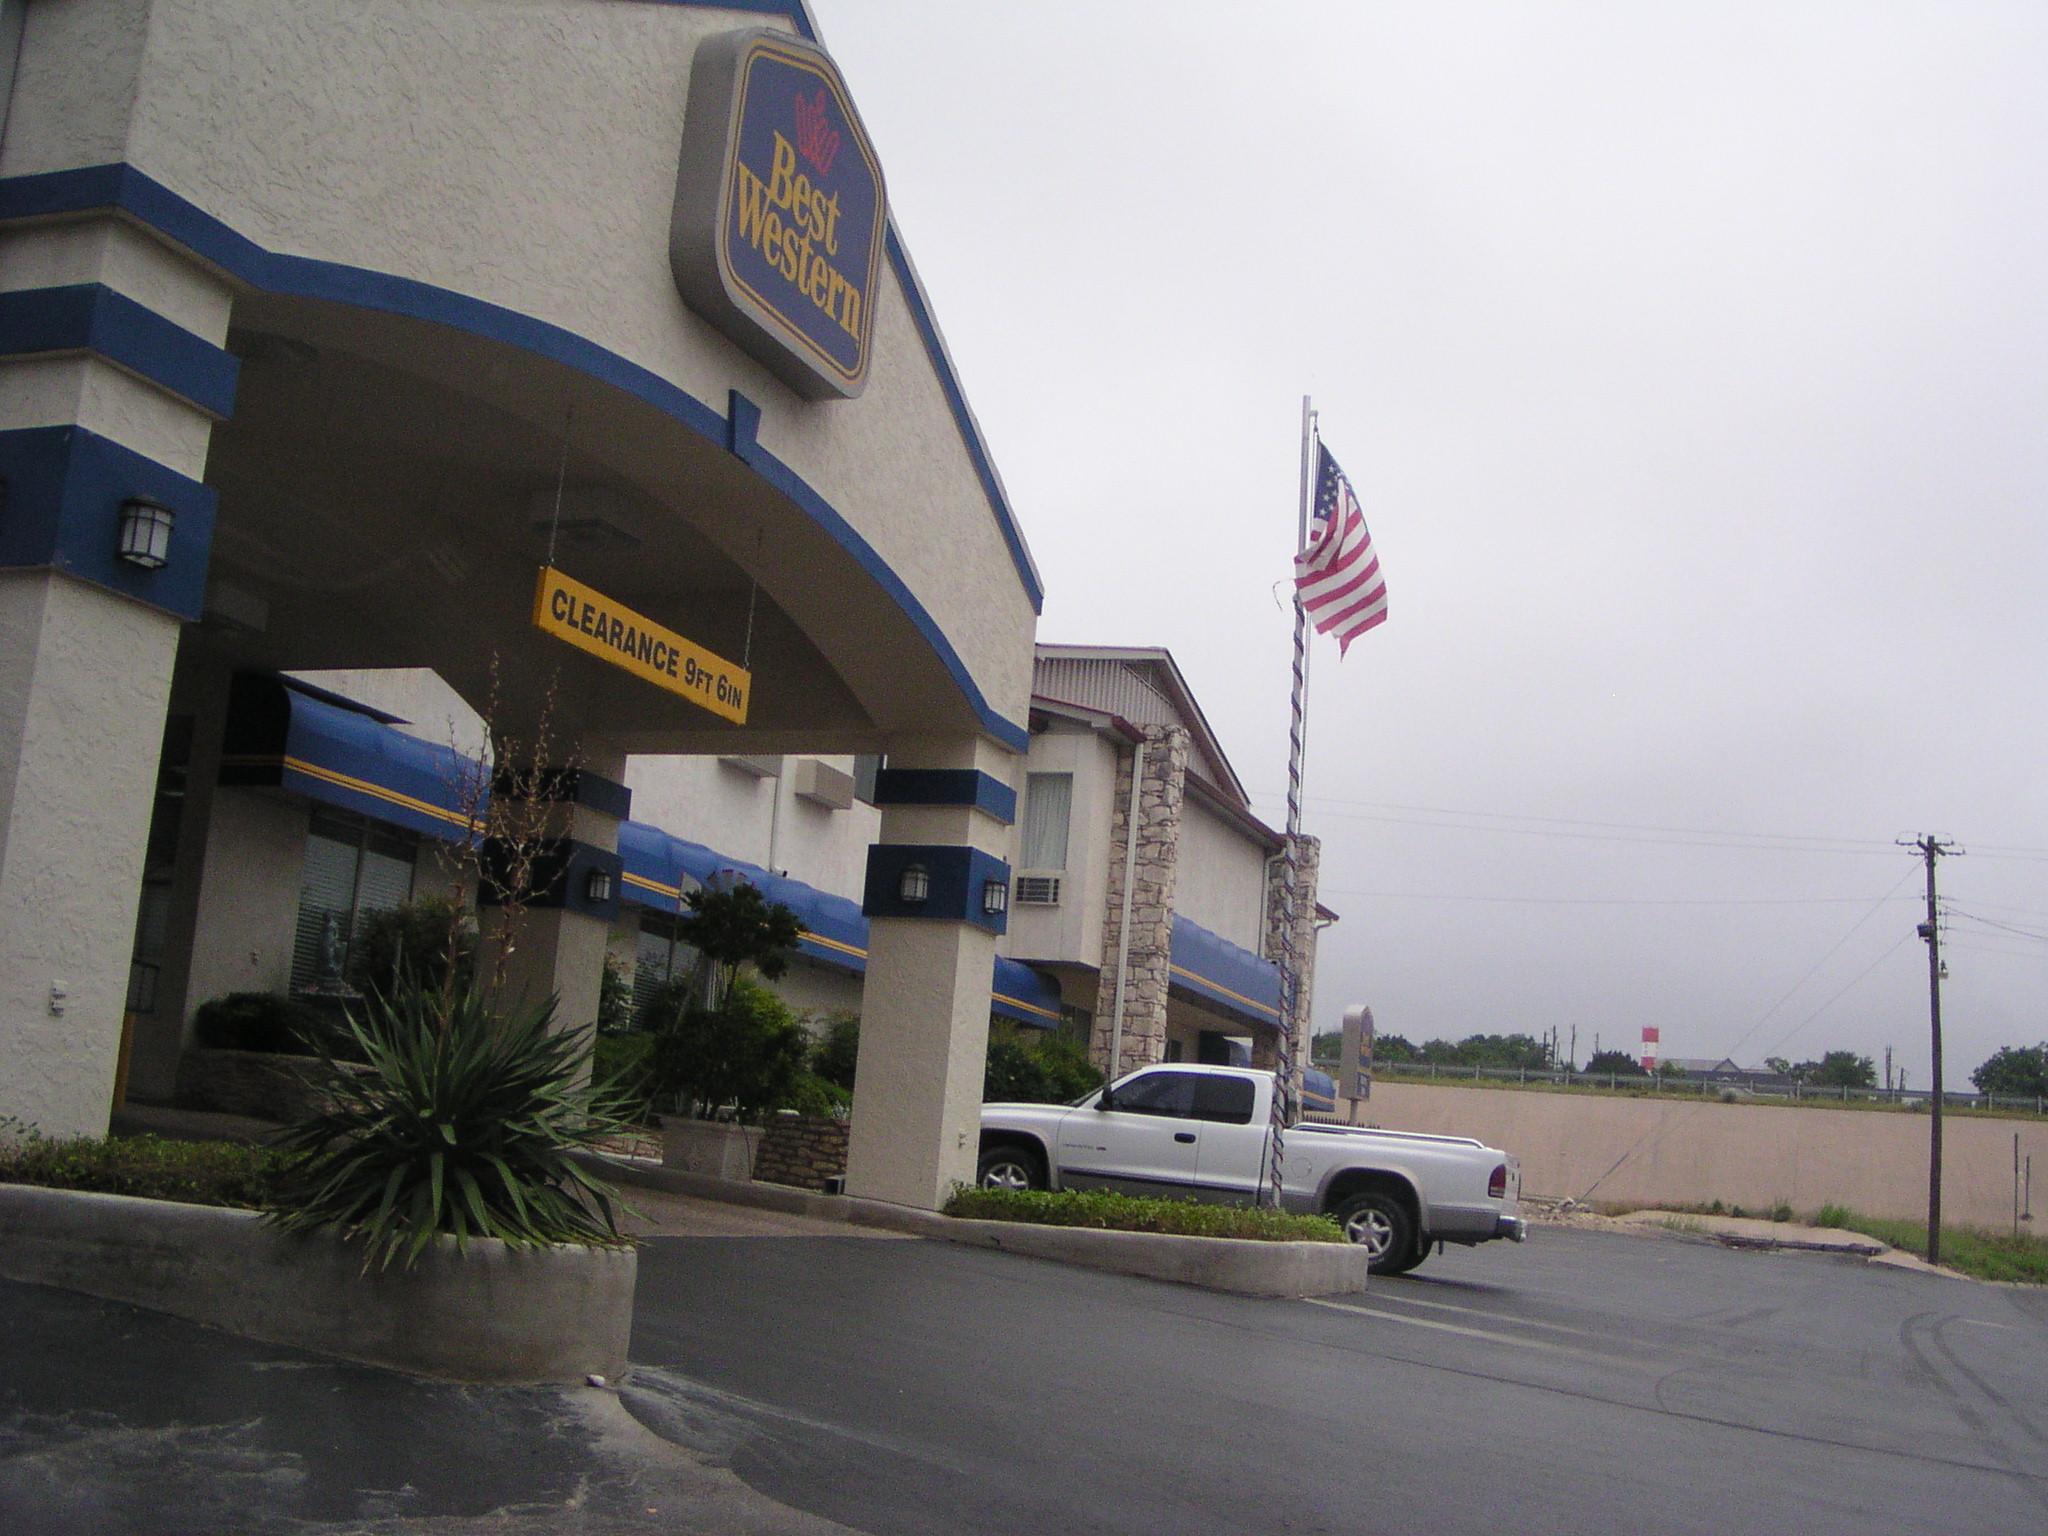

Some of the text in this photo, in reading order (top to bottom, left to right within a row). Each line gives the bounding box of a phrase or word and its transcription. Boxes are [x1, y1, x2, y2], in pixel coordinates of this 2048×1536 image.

[737, 160, 861, 341] Western
[767, 129, 841, 256] Best
[551, 588, 743, 710] CLEARANCE 9FT 6IN
